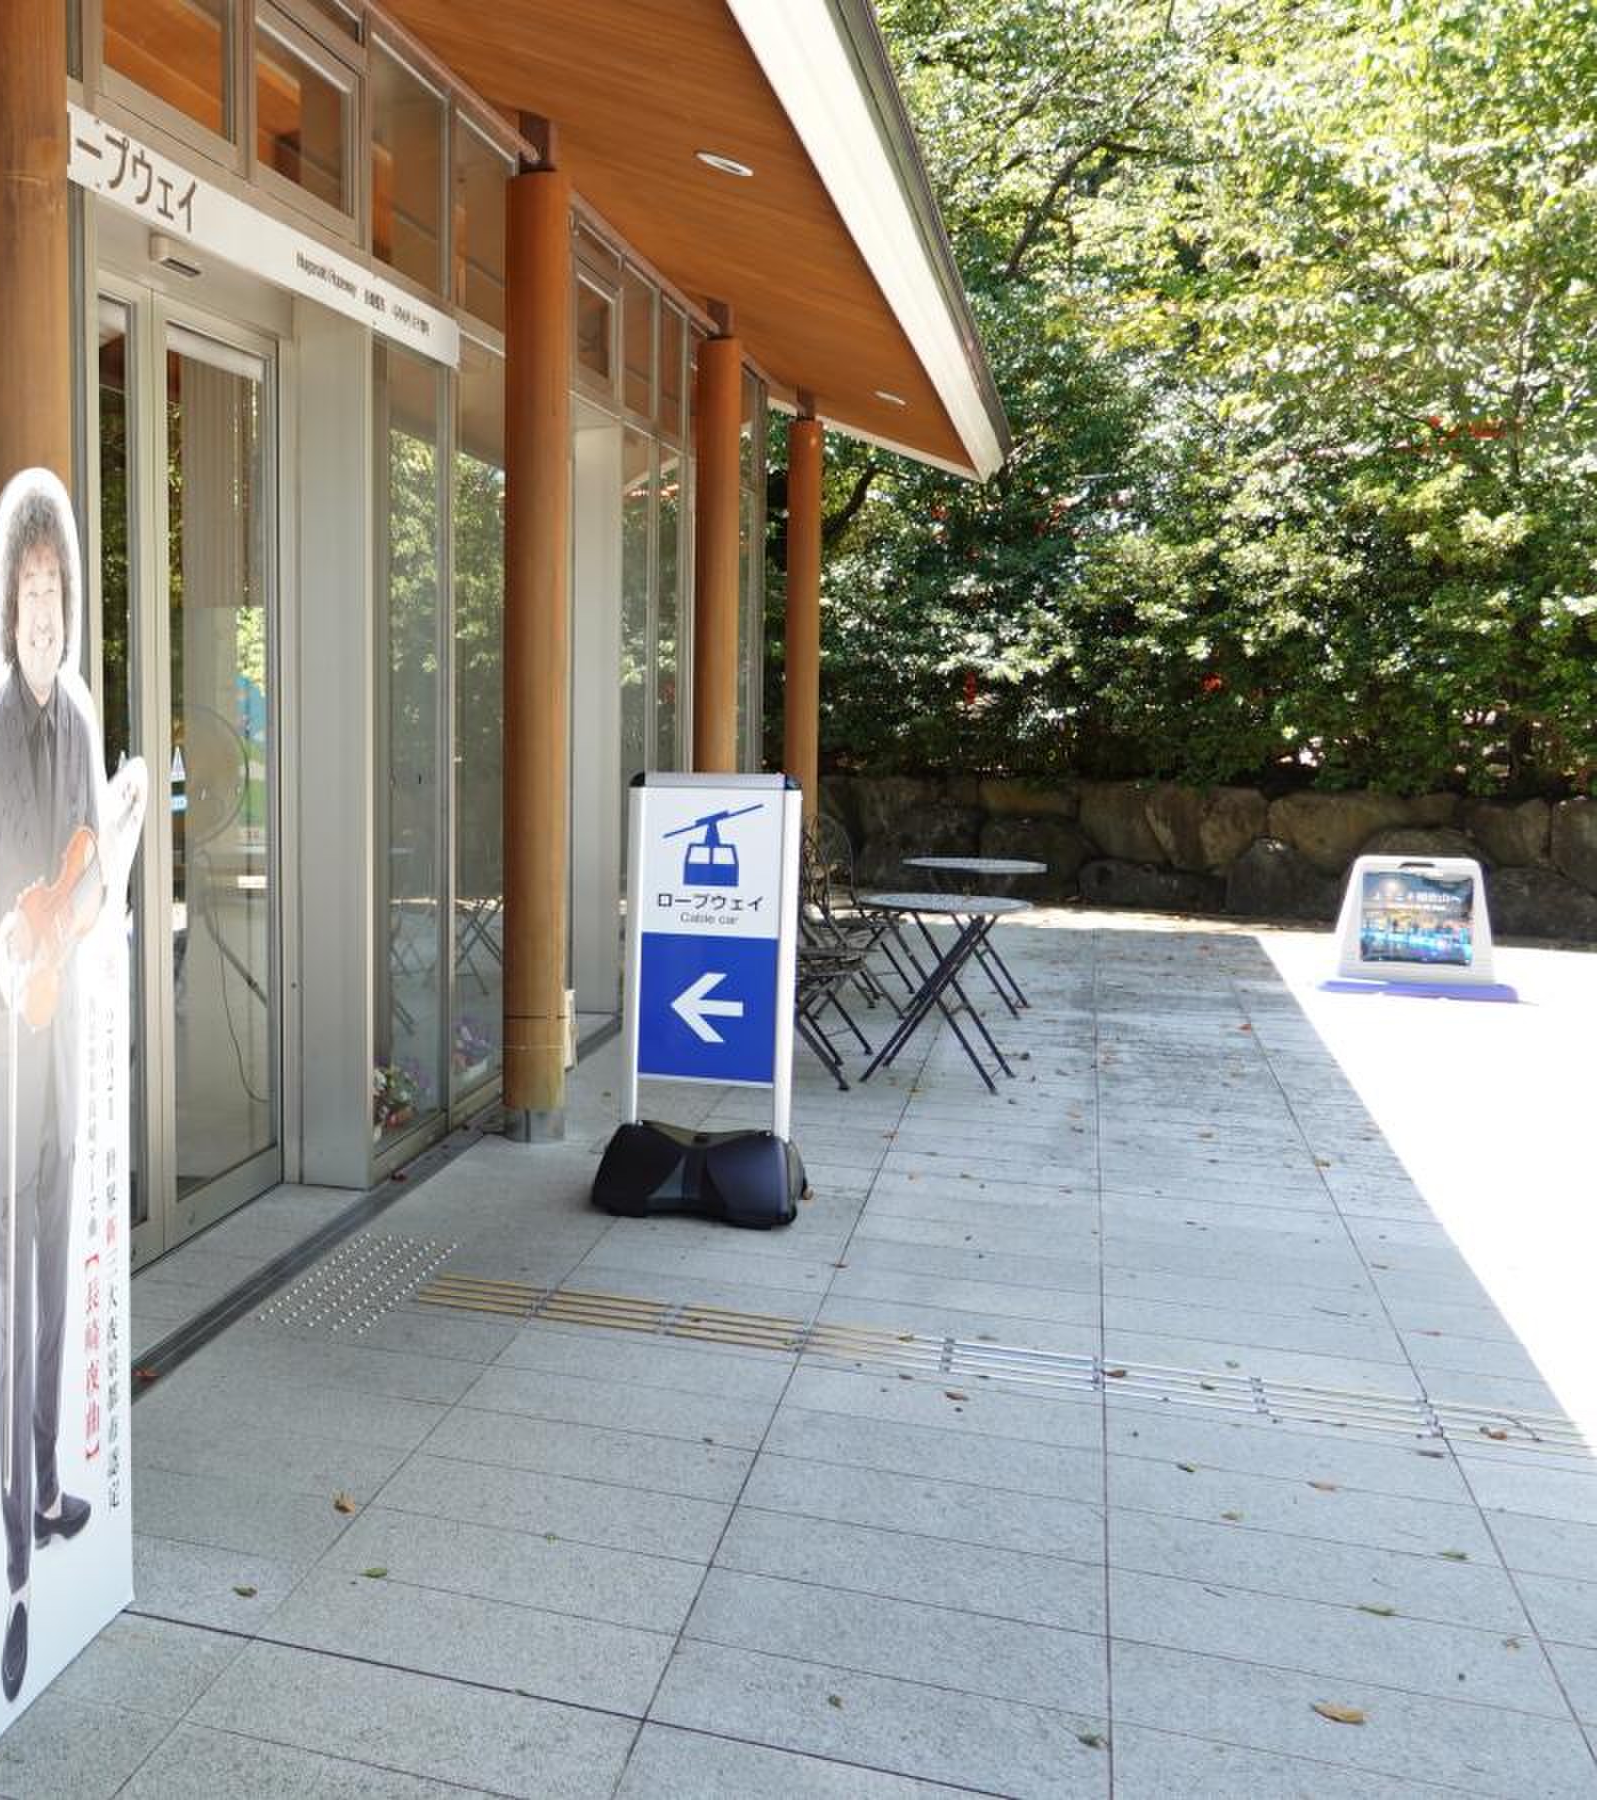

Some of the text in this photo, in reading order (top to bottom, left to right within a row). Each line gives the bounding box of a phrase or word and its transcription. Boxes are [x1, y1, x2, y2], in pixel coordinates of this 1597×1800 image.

[67, 112, 197, 233] ープウェイ
[658, 893, 764, 912] ロープウェイ
[680, 911, 739, 925] Cable car
